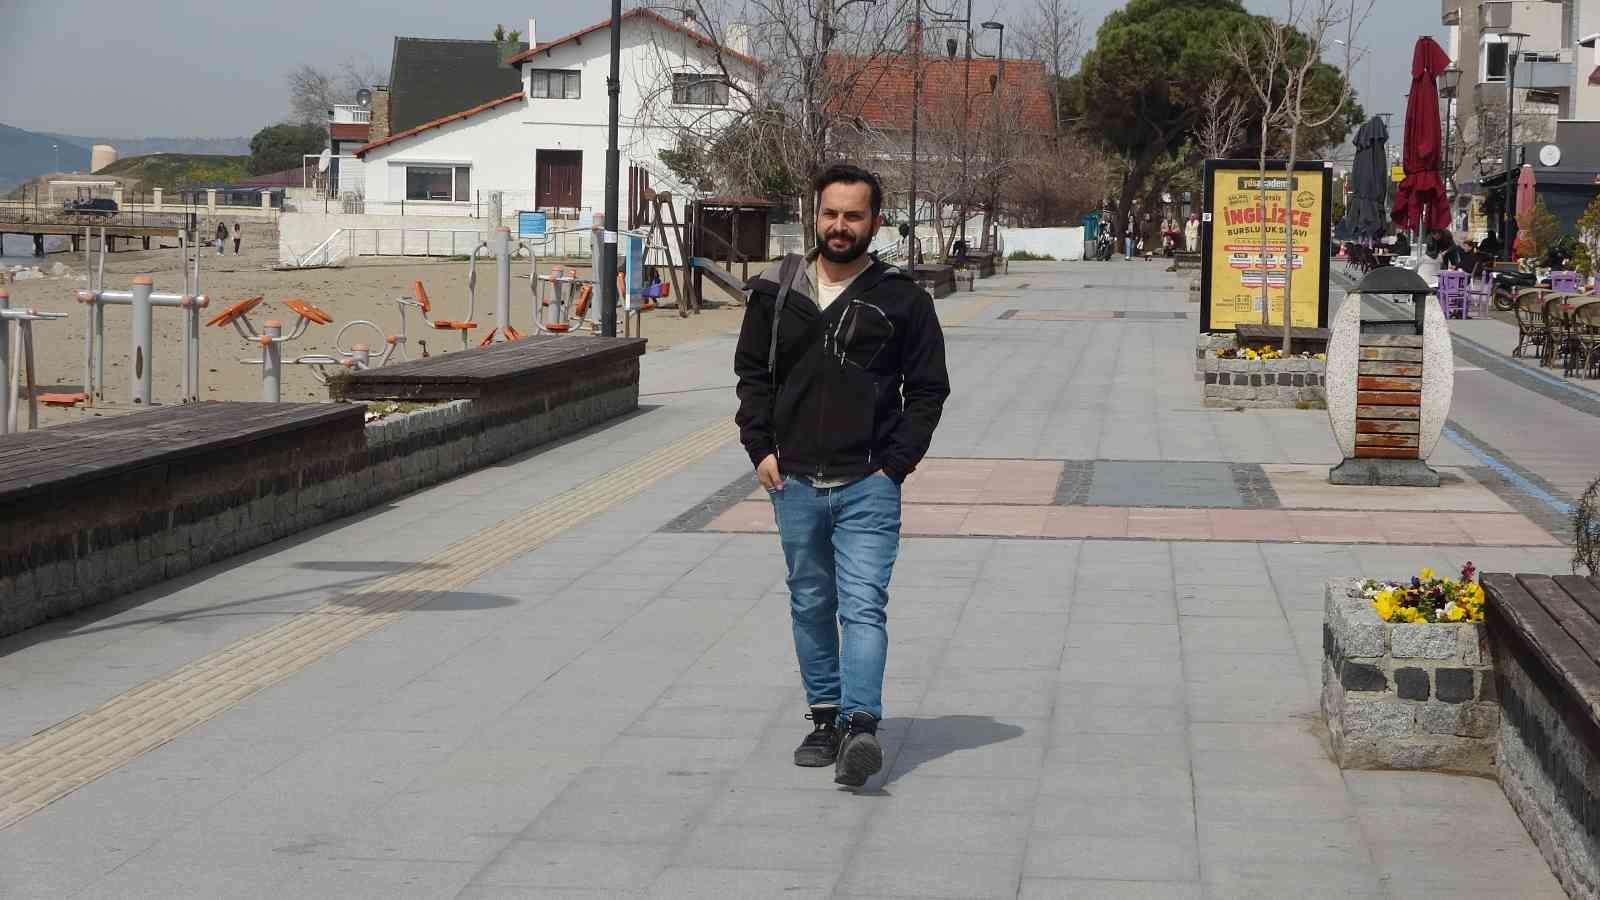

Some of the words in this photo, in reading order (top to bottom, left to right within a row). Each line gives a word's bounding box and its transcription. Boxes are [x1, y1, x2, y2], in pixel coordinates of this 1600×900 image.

[1223, 203, 1312, 228] İNGİLİZCE
[1227, 226, 1278, 236] BURSLUUK
[1279, 226, 1308, 237] SIAVI
